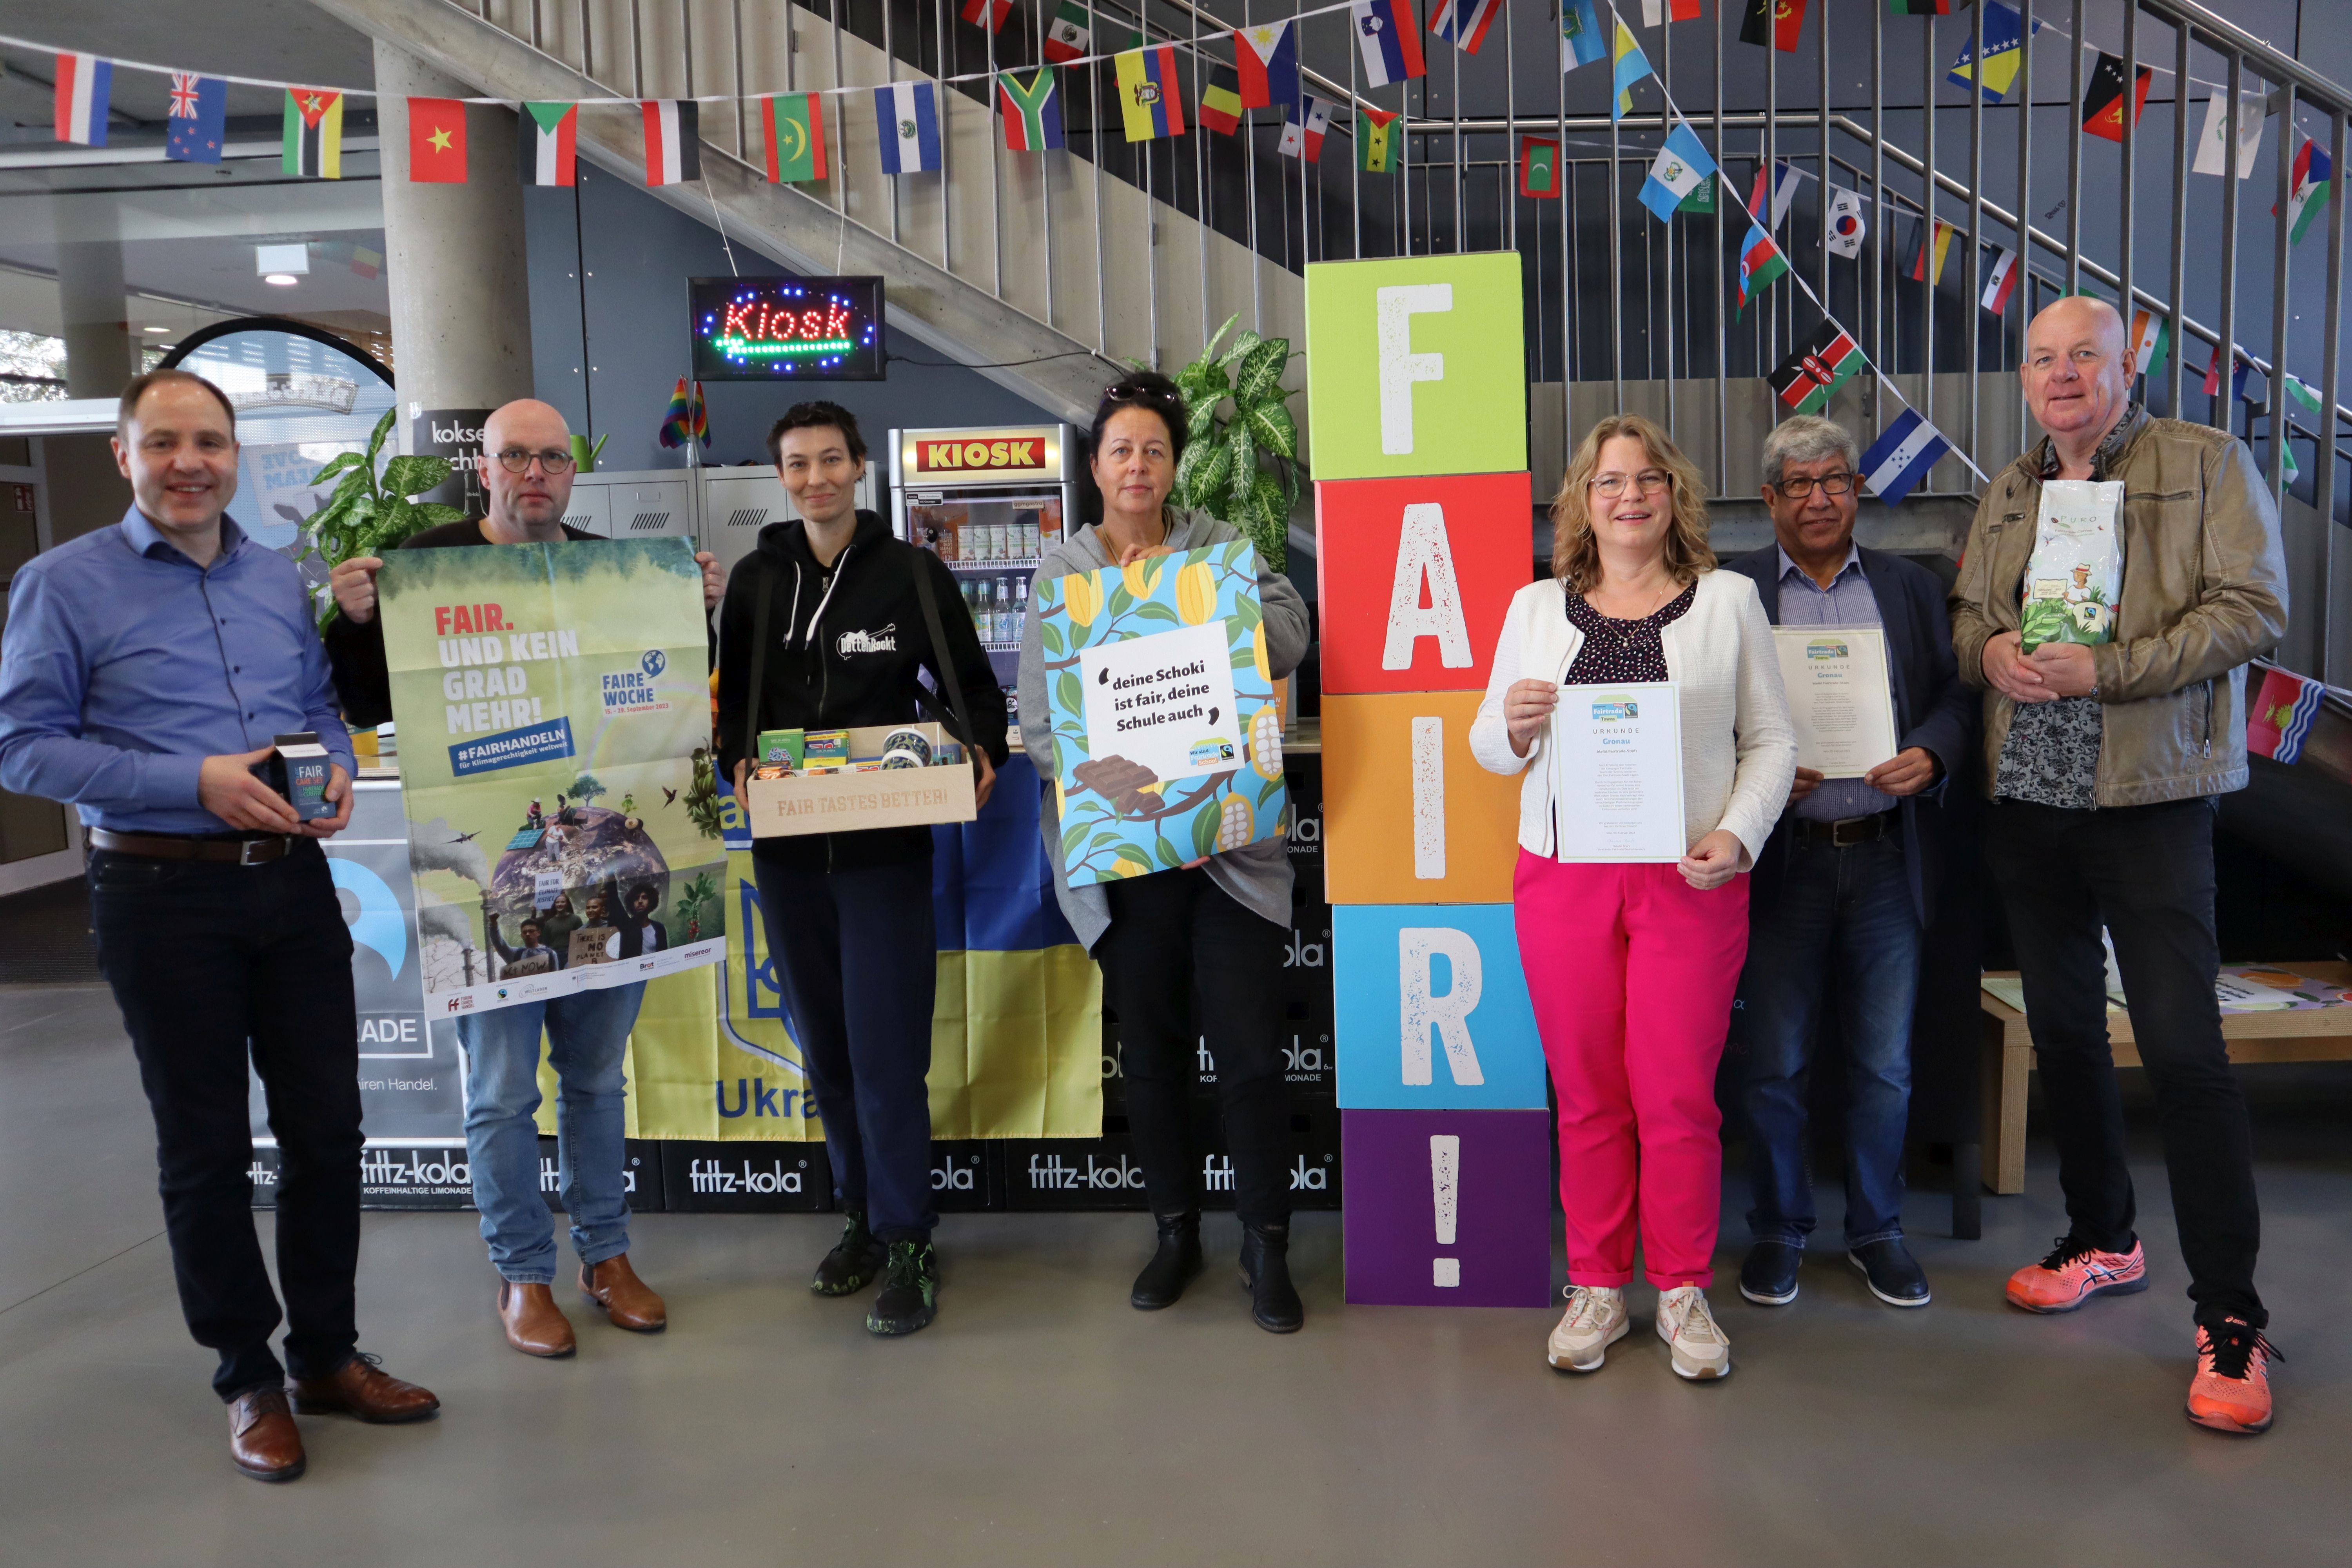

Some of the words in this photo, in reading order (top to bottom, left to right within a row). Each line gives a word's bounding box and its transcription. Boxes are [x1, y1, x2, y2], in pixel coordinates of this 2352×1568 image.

[723, 303, 849, 340] Kiosk
[432, 420, 485, 443] kokse
[928, 441, 1035, 468] KIOSK
[434, 603, 514, 635] FAIR.
[438, 636, 503, 668] UND
[509, 630, 579, 661] KEIN
[443, 666, 527, 701] GRAD
[603, 672, 644, 690] FAIRE
[1112, 671, 1154, 691] deine
[1156, 660, 1205, 682] Schoki
[603, 687, 654, 706] WOCHE
[627, 704, 655, 713] September
[1114, 696, 1134, 711] ist
[1135, 692, 1166, 709] fair,
[1168, 682, 1210, 701] deine
[446, 697, 542, 734] MEHR!
[1117, 713, 1165, 732] Schule
[1168, 704, 1203, 722] auch
[458, 729, 565, 762] #FAIRHANDELN
[472, 748, 537, 766] Klimagerechtigkeit
[539, 741, 568, 752] weltweit
[1191, 752, 1219, 760] Fairtrade
[299, 765, 323, 778] FAIR
[777, 798, 814, 817] FAIR
[817, 793, 877, 813] TASTES
[881, 788, 948, 809] BETTER!
[576, 933, 593, 943] THERE
[588, 942, 604, 951] NO
[521, 961, 546, 972] NOW
[576, 952, 604, 961] PLANET
[684, 947, 712, 960] misereor
[358, 1079, 384, 1090] airen
[388, 1078, 437, 1091] Handel.
[716, 1078, 820, 1119] Ukra
[360, 1149, 471, 1184] fritz-kola
[690, 1160, 801, 1193] fritz-kola
